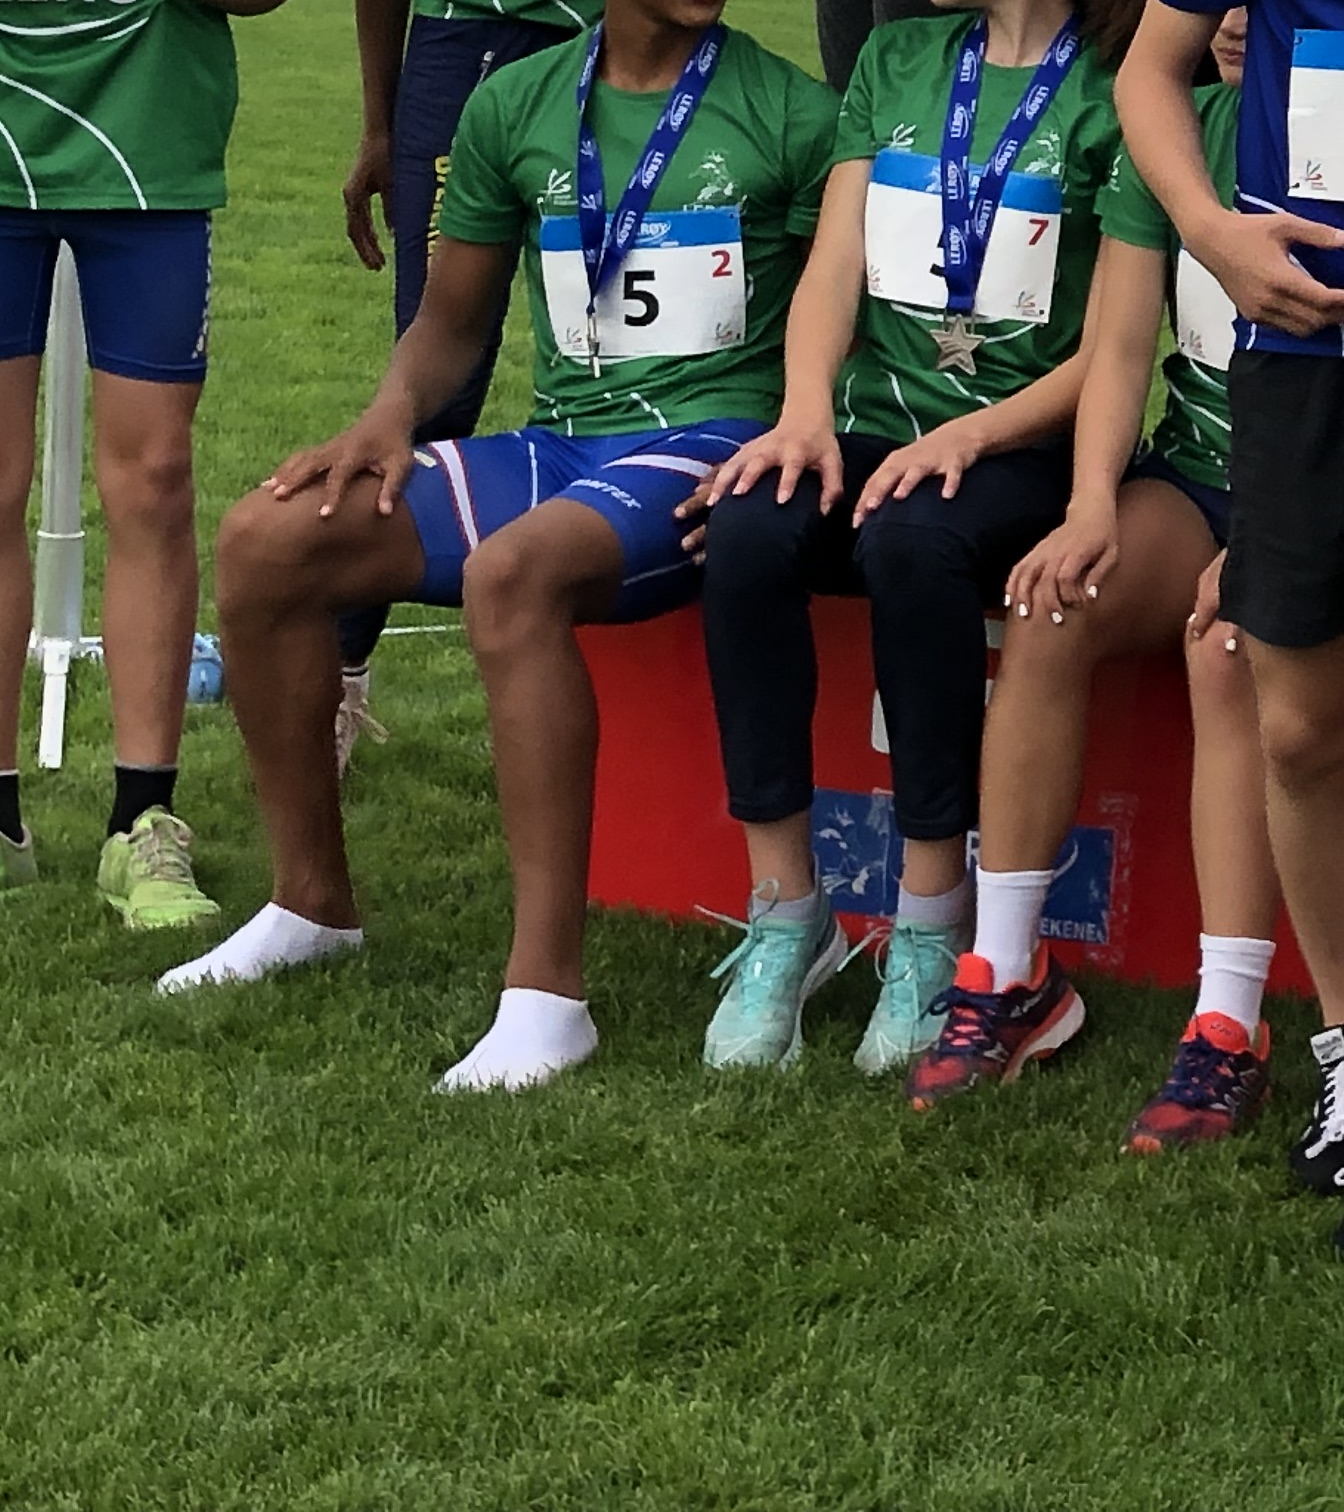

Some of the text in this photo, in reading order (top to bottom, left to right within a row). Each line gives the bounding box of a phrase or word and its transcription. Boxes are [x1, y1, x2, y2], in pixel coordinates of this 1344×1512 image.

[640, 222, 668, 236] RØY
[1028, 219, 1049, 246] 7
[712, 250, 733, 277] 2
[623, 270, 660, 326] 5
[1040, 918, 1098, 941] EKENE
